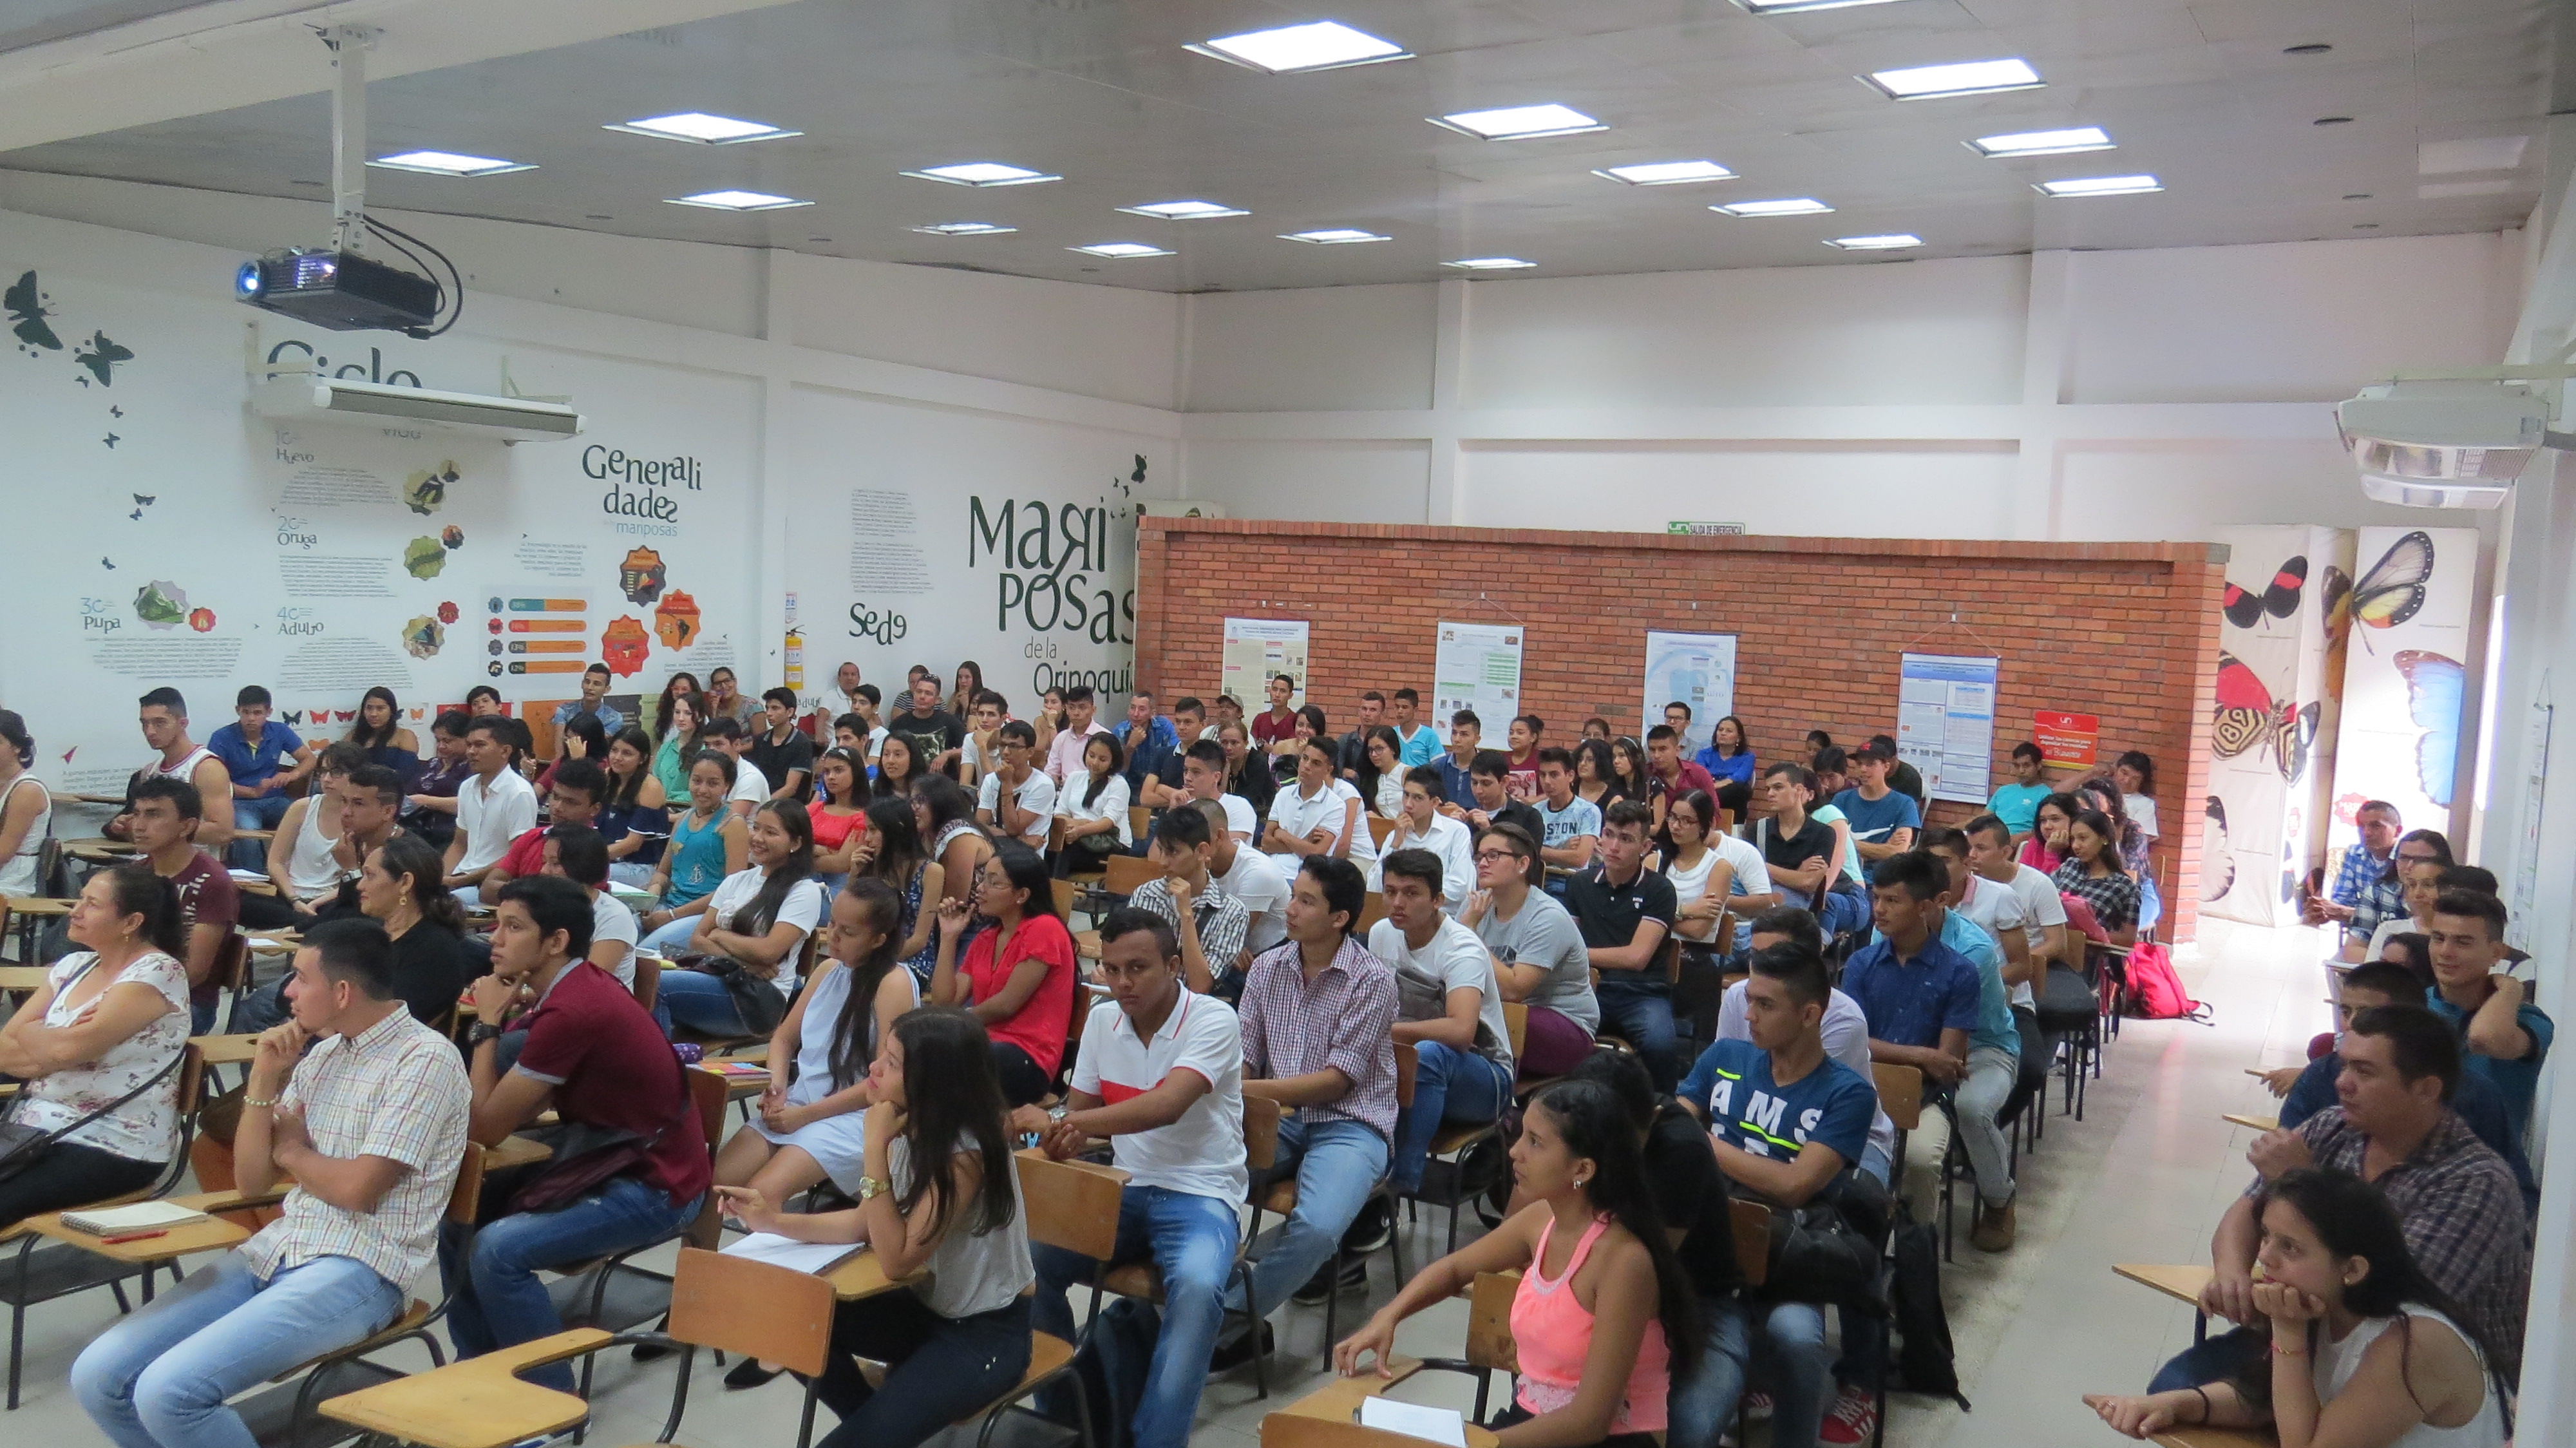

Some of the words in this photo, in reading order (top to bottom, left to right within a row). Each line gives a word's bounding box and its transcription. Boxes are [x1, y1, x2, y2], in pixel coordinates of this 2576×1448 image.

[582, 444, 703, 491] Generali
[603, 483, 678, 523] dades
[278, 532, 317, 549] Oruga
[84, 616, 121, 634] Pupa
[1024, 636, 1043, 659] de
[1046, 636, 1057, 659] la
[1034, 661, 1133, 703] Orinoquí
